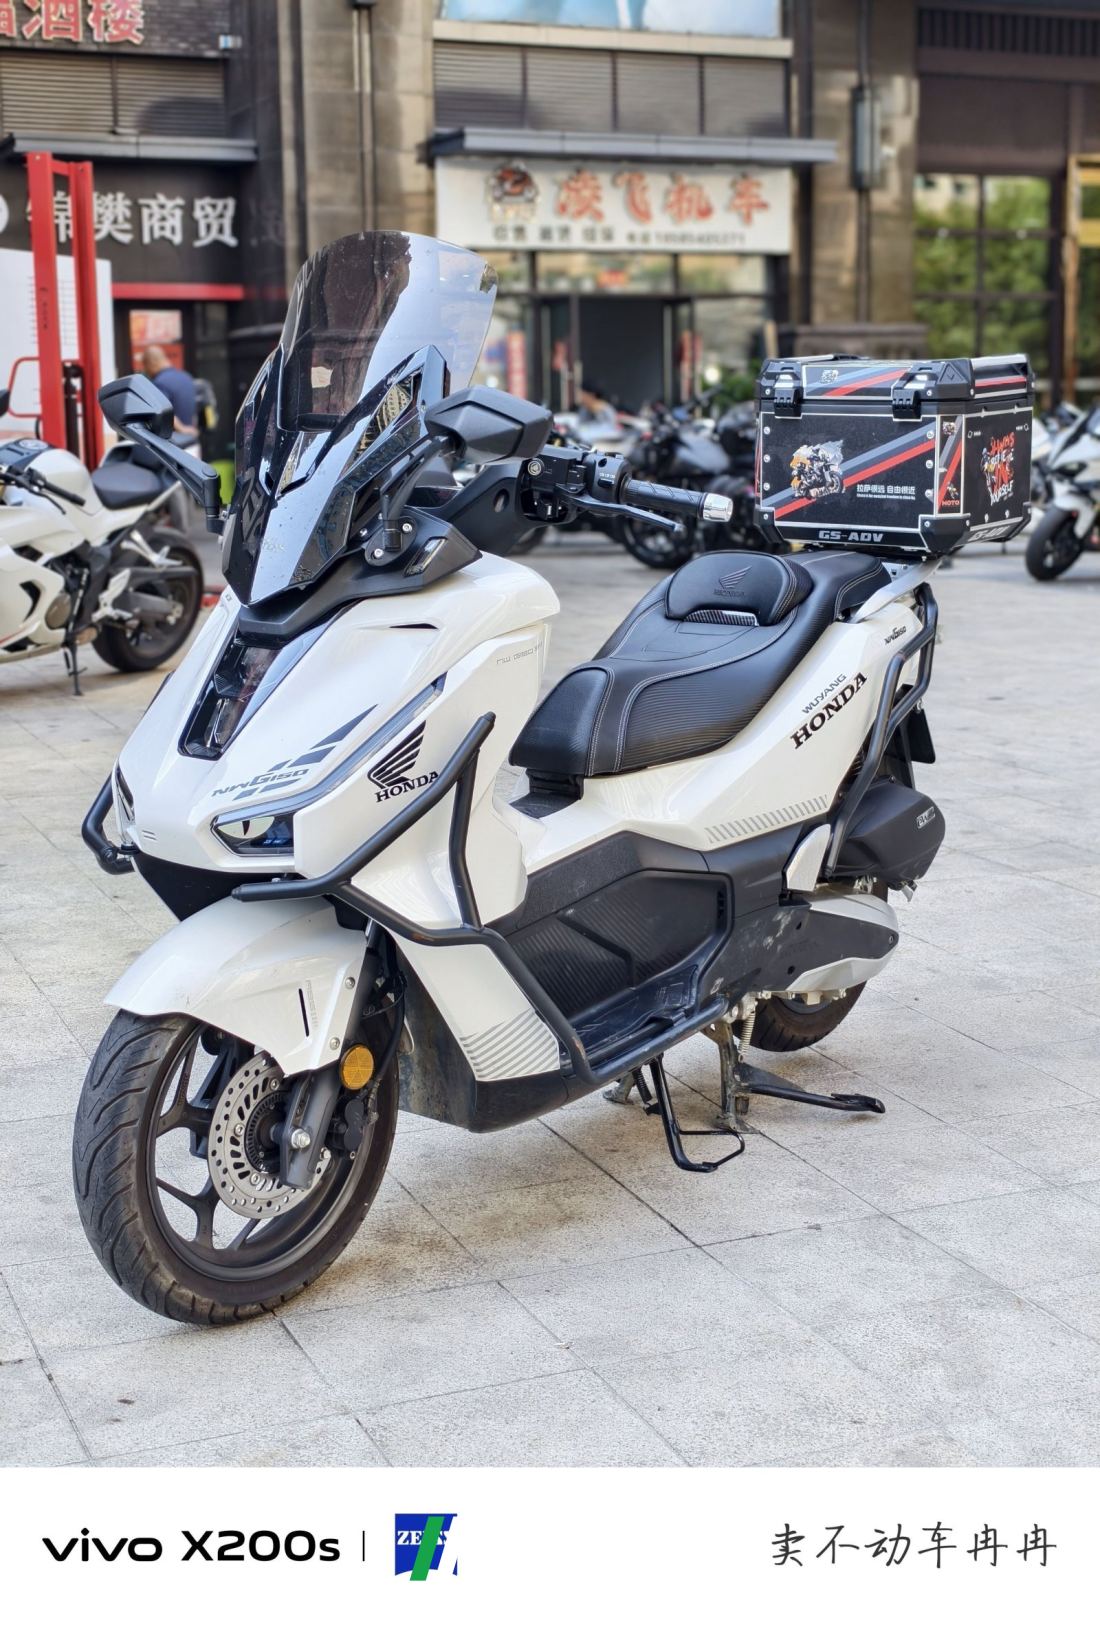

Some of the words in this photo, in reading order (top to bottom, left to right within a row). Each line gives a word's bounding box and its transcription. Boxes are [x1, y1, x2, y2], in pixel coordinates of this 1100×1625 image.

[818, 529, 885, 544] GS-ADV
[789, 672, 868, 749] HONDA
[802, 673, 848, 714] WUYANG
[375, 770, 440, 804] HONDA
